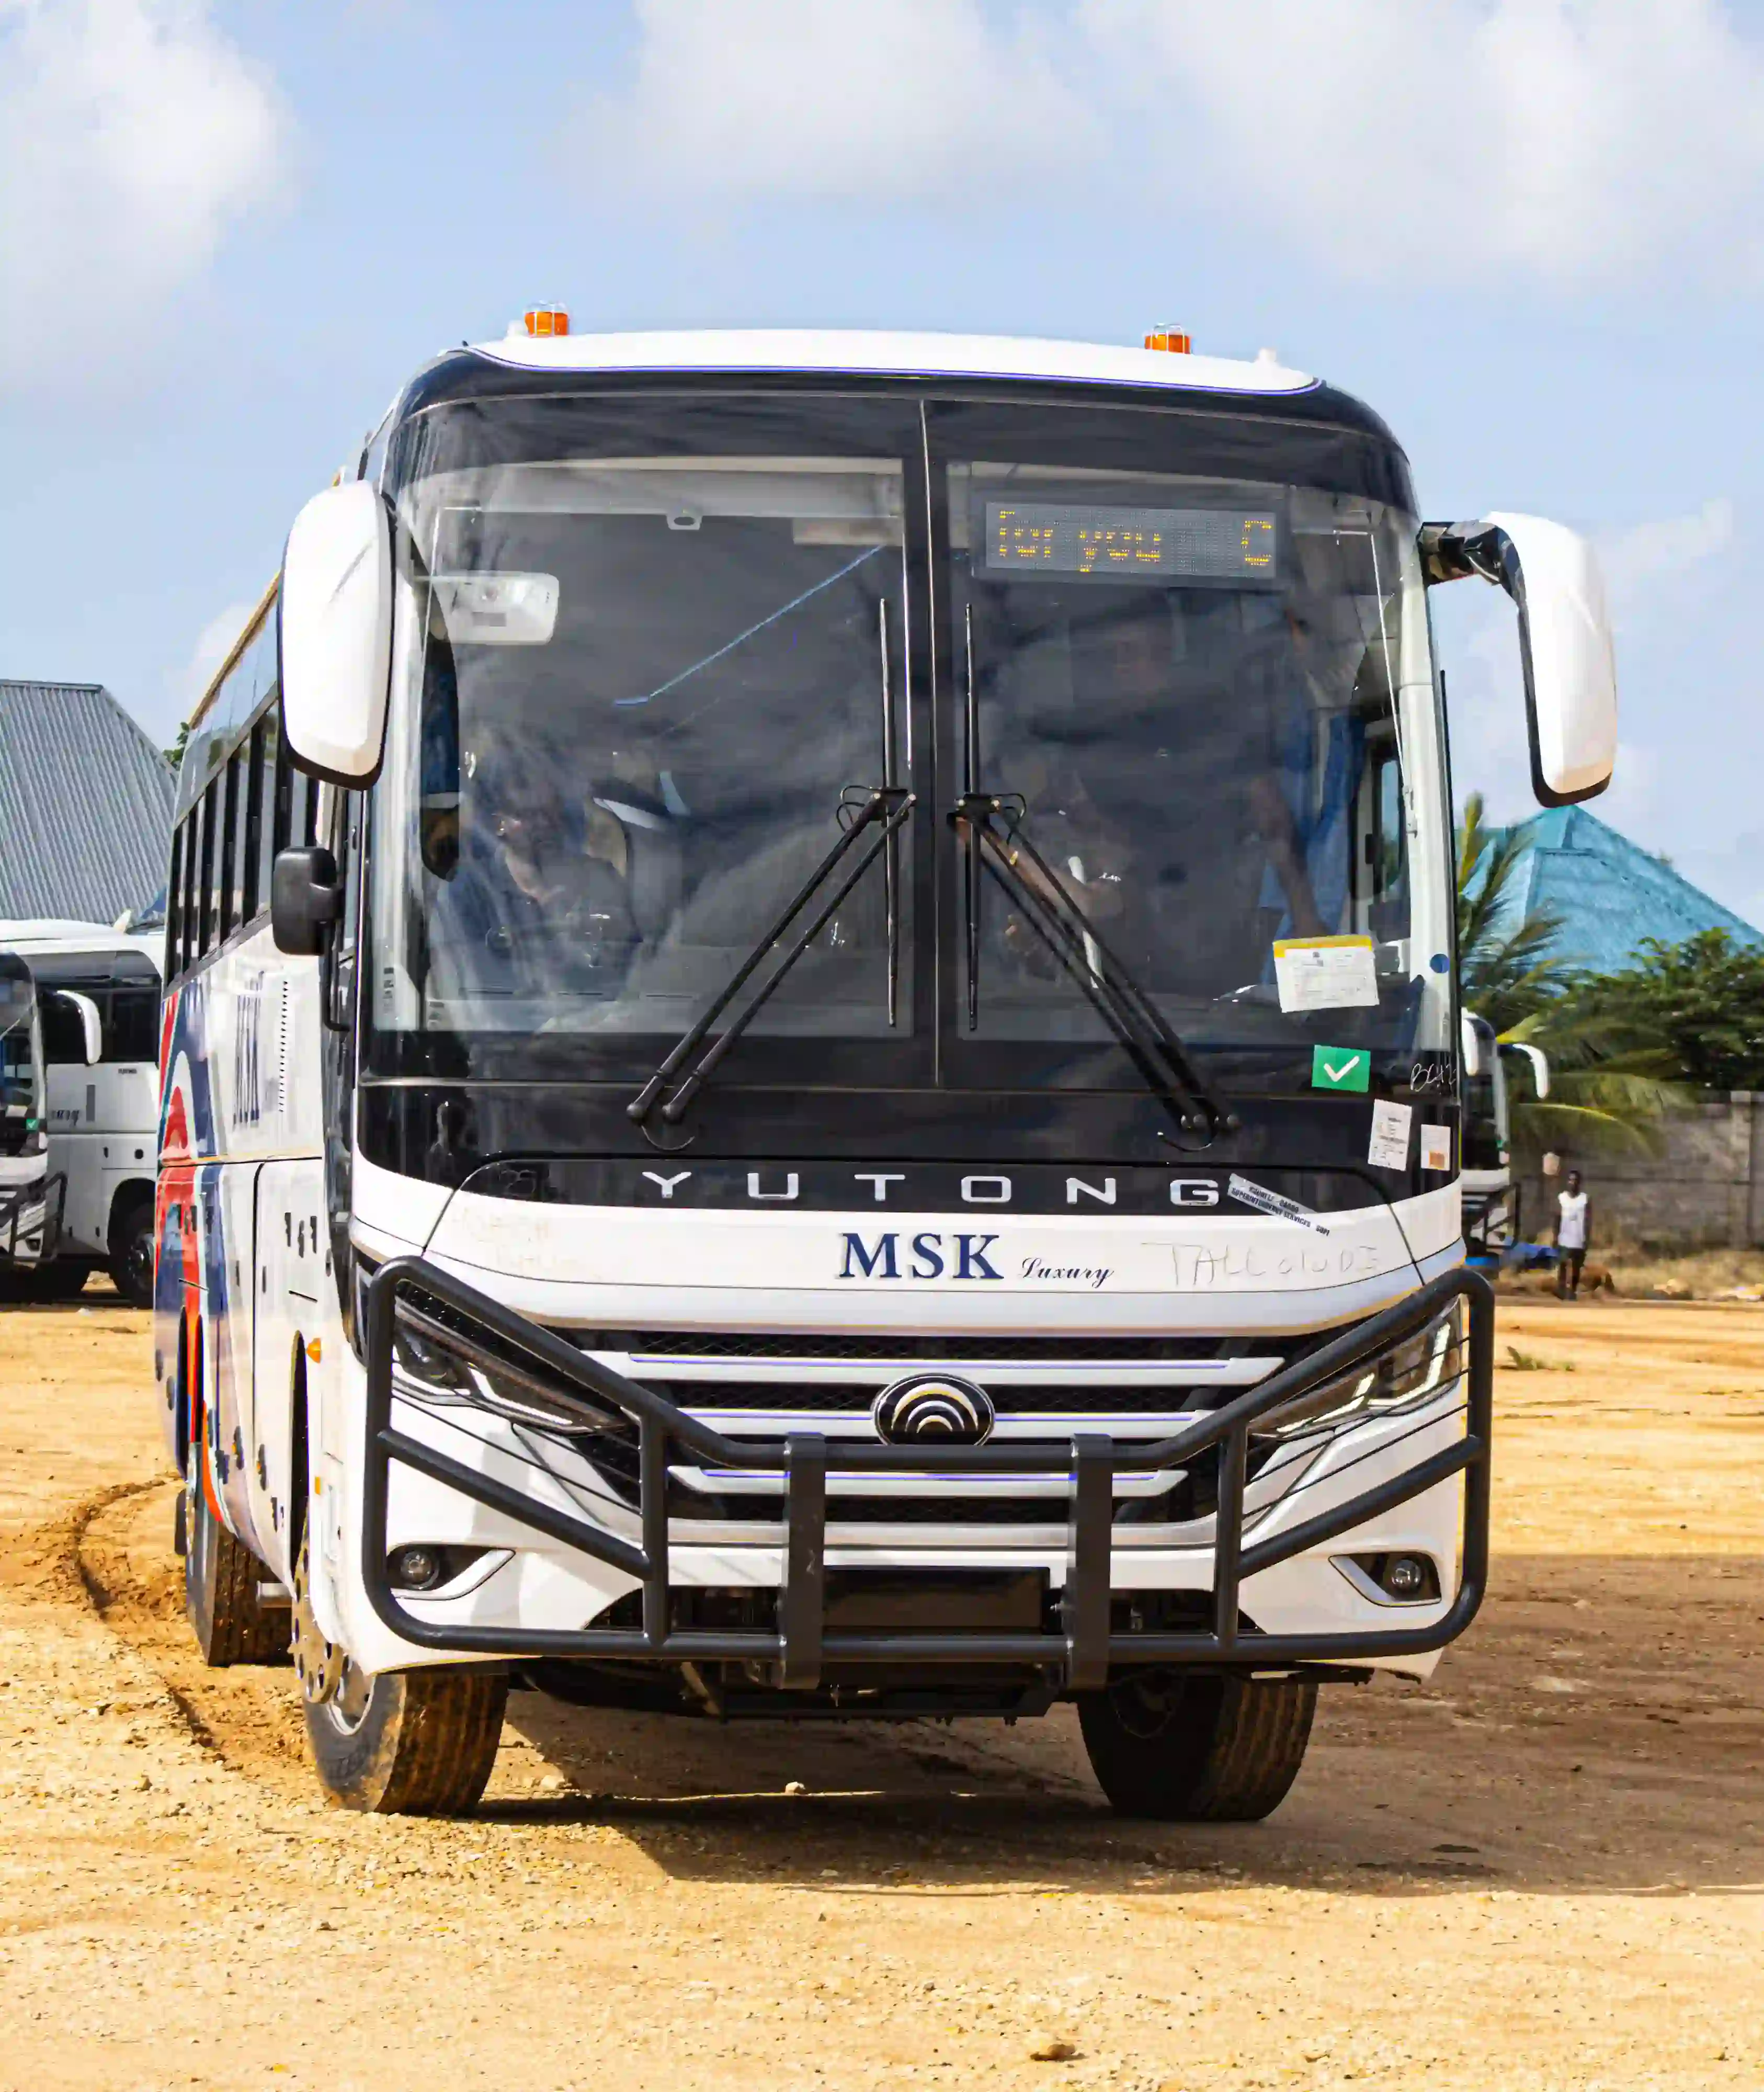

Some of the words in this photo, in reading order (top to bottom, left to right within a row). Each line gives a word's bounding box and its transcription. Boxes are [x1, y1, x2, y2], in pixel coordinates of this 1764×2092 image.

[642, 1171, 1220, 1206] YUTONG
[838, 1232, 1004, 1279] MSK
[1021, 1257, 1115, 1289] Luxury
